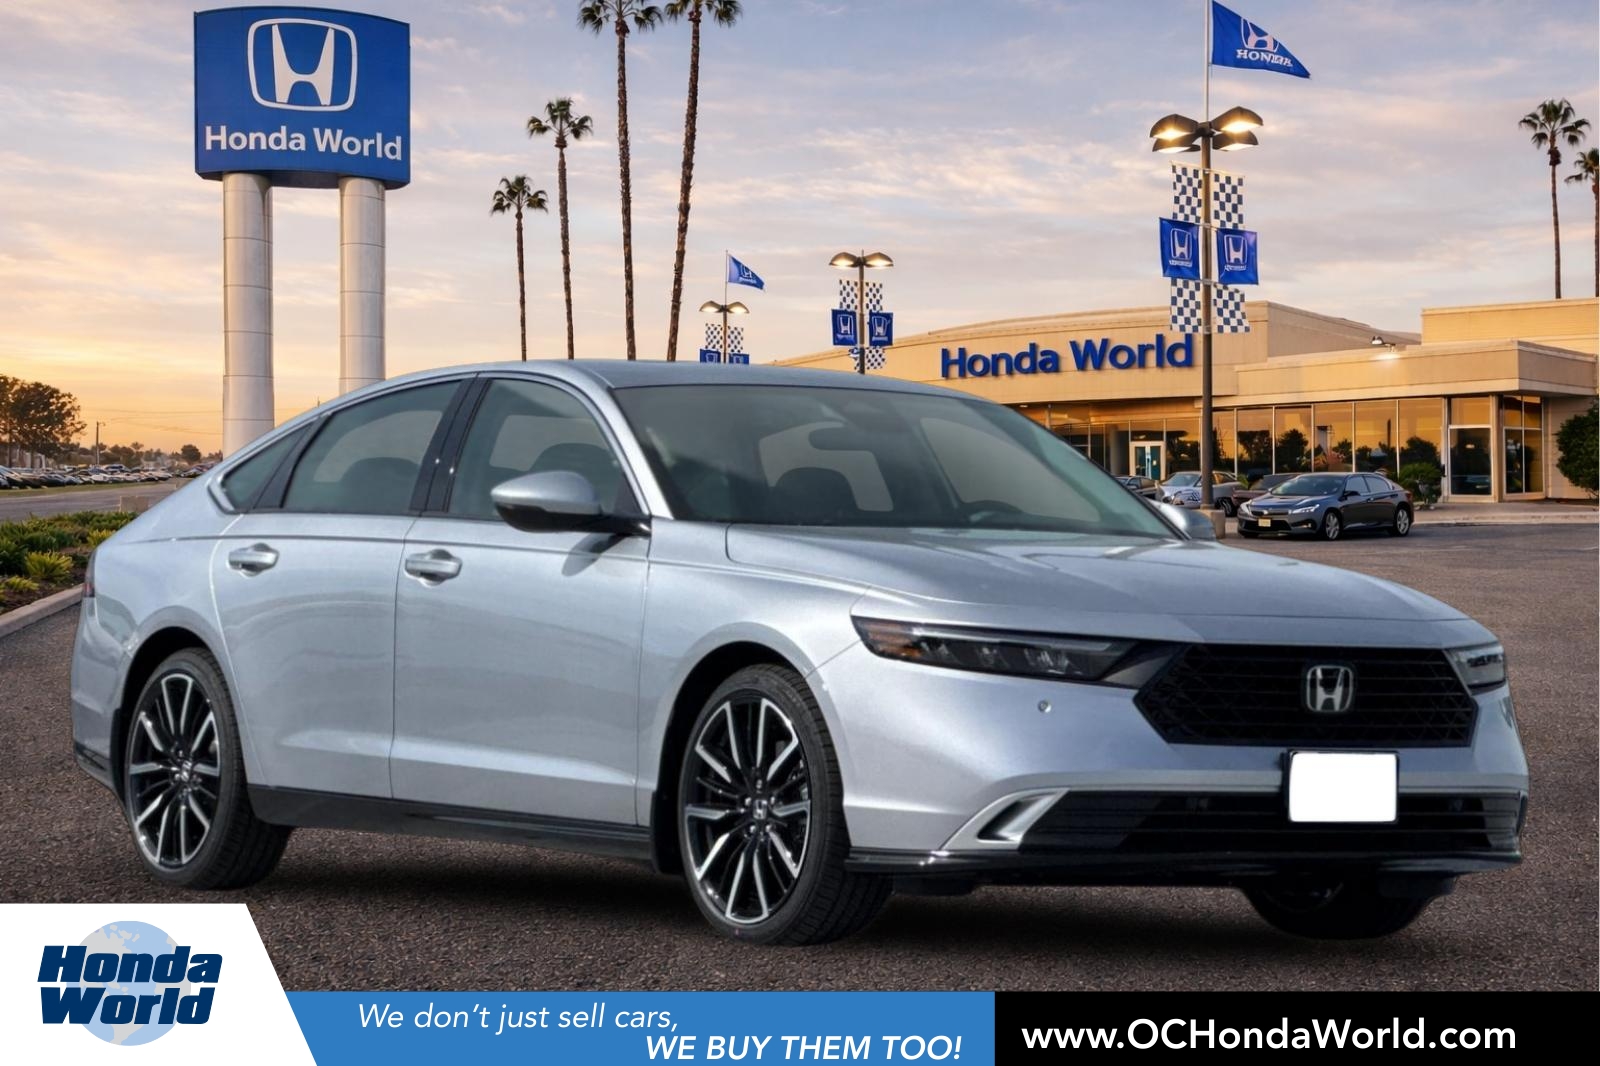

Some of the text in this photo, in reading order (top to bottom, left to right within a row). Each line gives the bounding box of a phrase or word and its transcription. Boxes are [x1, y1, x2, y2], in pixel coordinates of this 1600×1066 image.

[205, 125, 402, 161] Honda World
[941, 332, 1194, 378] Honda World
